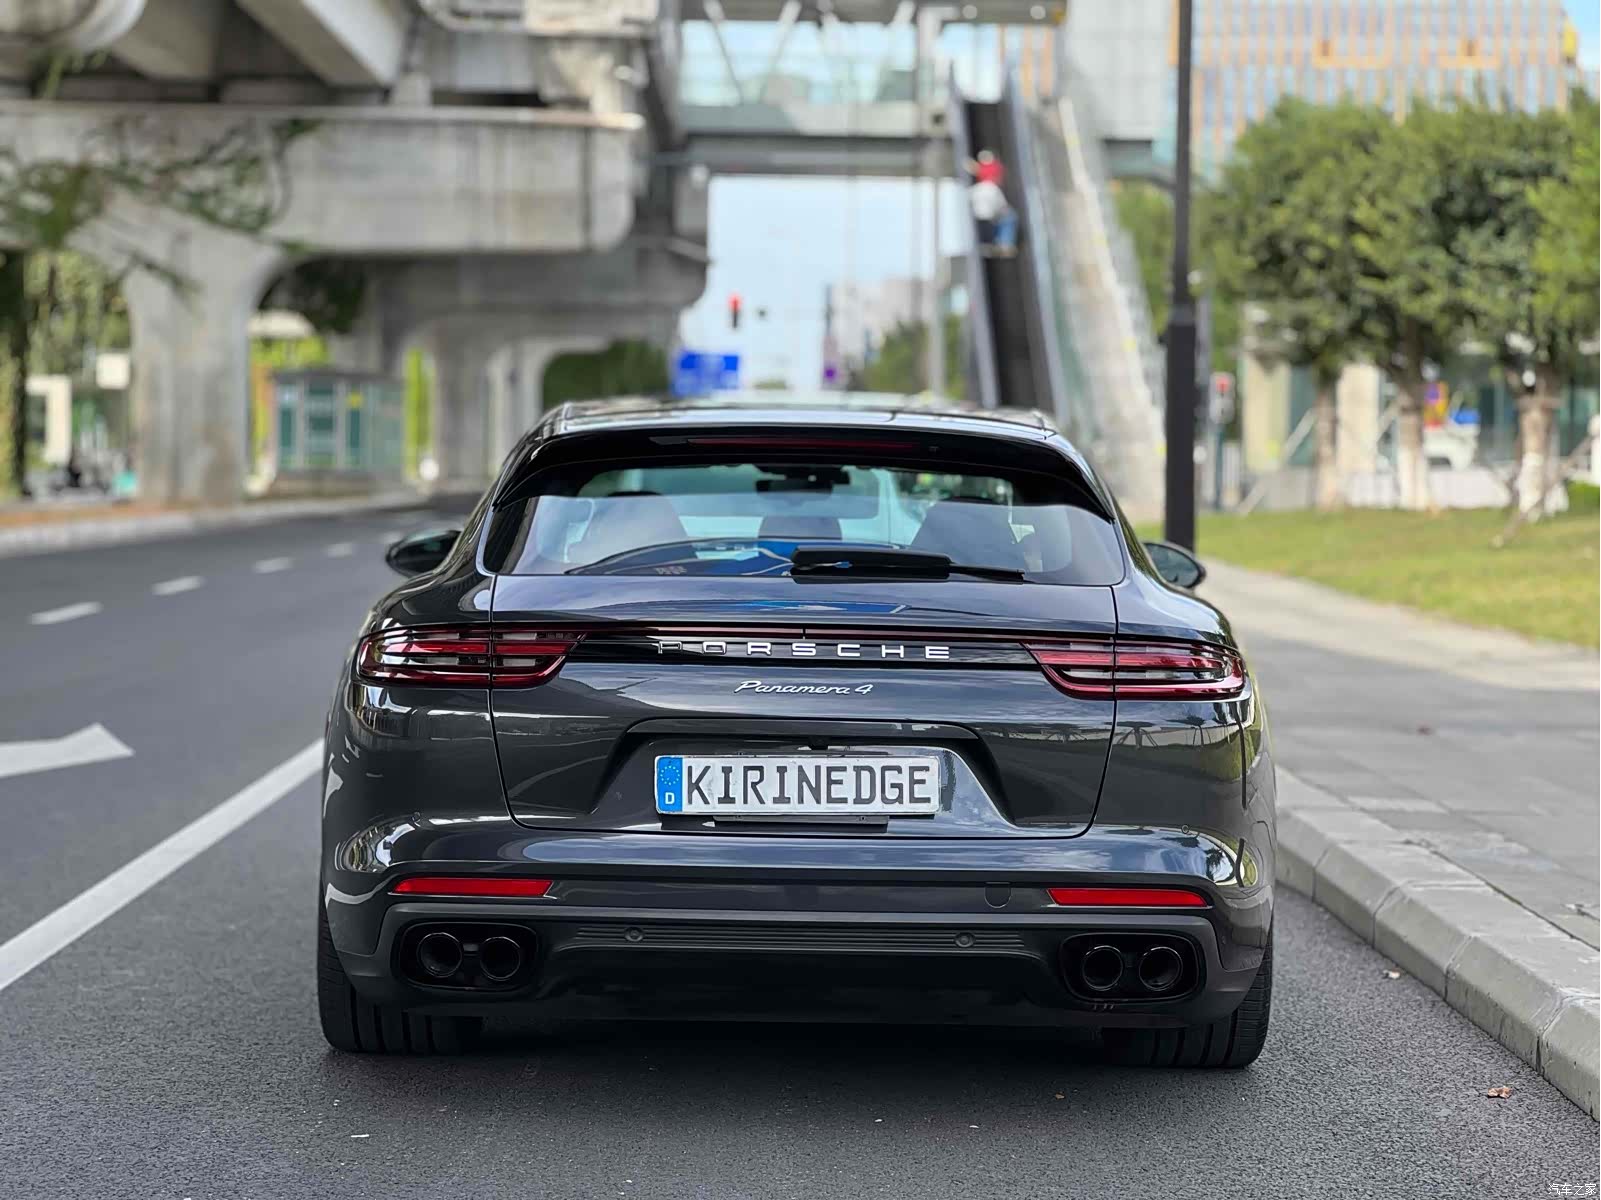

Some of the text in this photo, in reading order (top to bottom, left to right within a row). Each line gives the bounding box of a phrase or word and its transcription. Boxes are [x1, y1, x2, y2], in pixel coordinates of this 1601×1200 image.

[657, 640, 951, 659] PORSCHE
[734, 680, 874, 695] Panamera 4
[687, 765, 932, 805] KIRINEDGE
[665, 792, 675, 804] D
